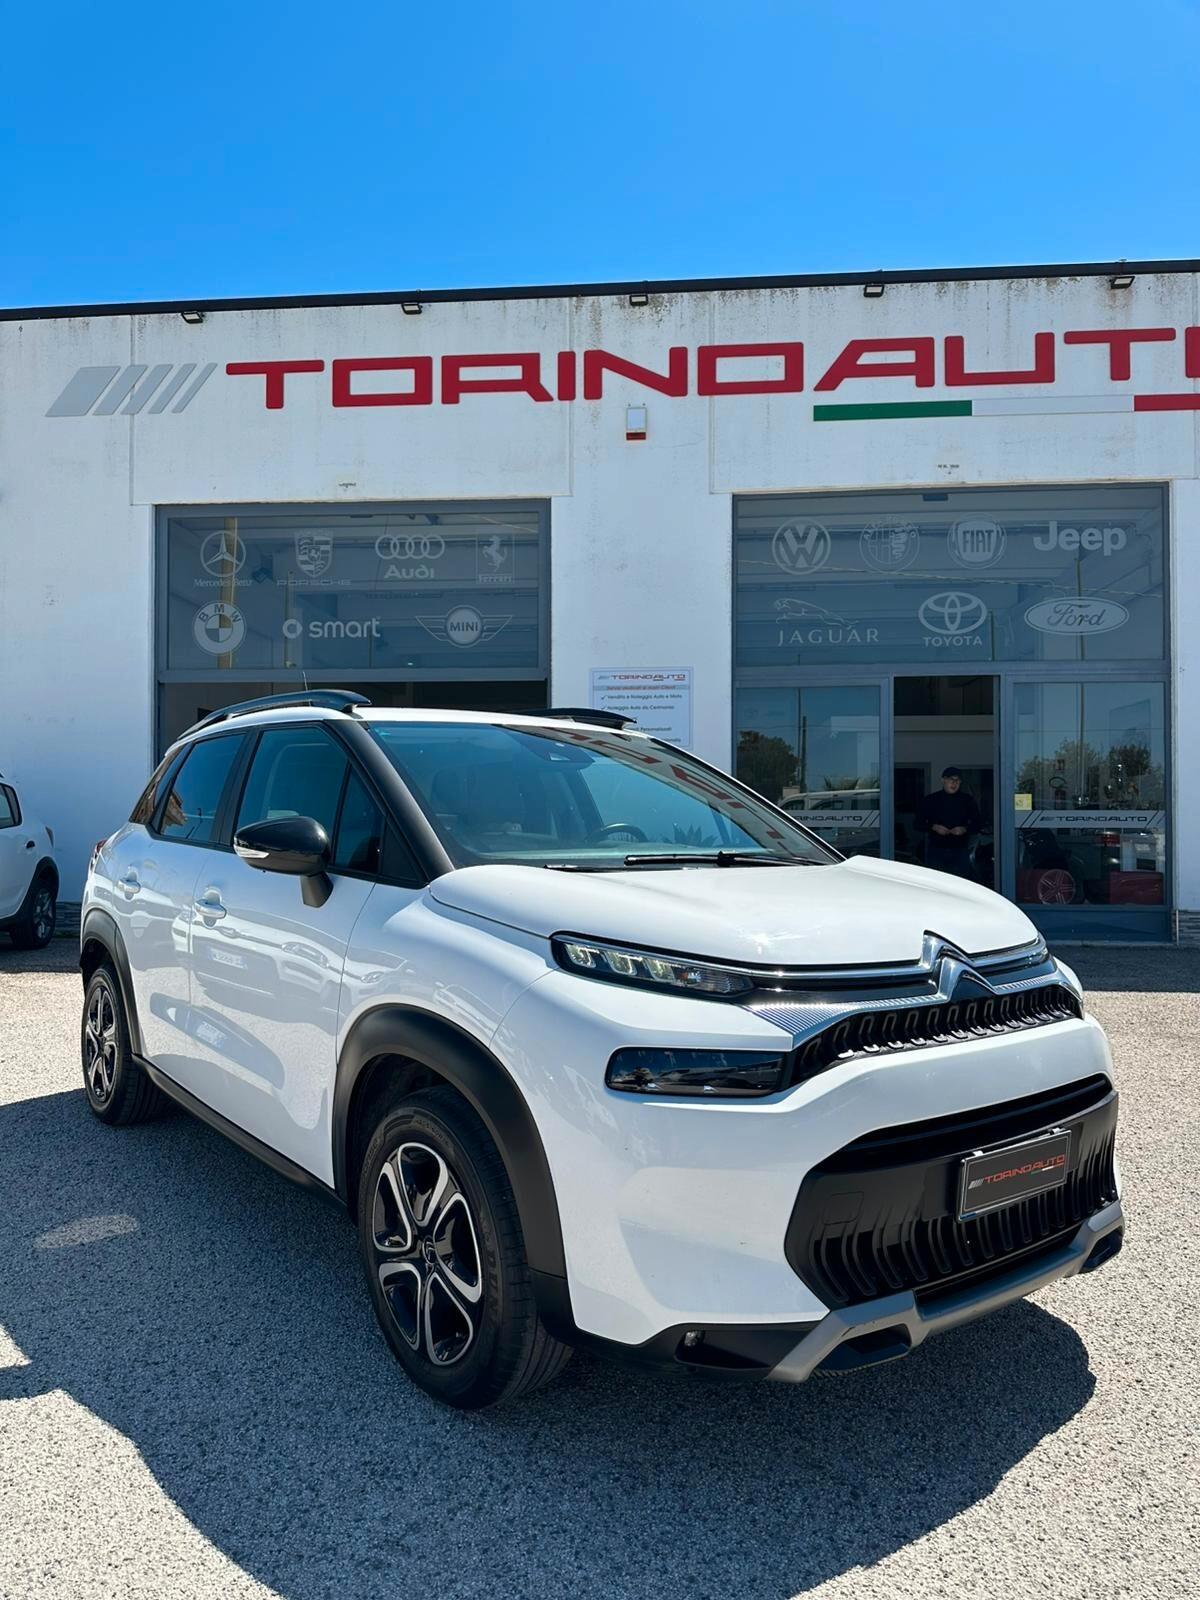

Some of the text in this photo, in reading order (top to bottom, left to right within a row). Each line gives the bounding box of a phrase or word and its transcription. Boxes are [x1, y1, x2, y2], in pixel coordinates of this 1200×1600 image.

[225, 327, 1200, 409] TORINOAUT
[962, 529, 994, 553] FIAT
[1033, 520, 1127, 556] Jeep
[383, 564, 435, 579] Audi
[198, 603, 242, 623] BMW
[1047, 603, 1106, 627] Ford
[309, 617, 381, 638] smart
[449, 621, 479, 632] MINI
[778, 628, 880, 647] JAGUAR
[923, 636, 983, 647] TOYOTA
[984, 1154, 1065, 1183] TORINOAUTO
